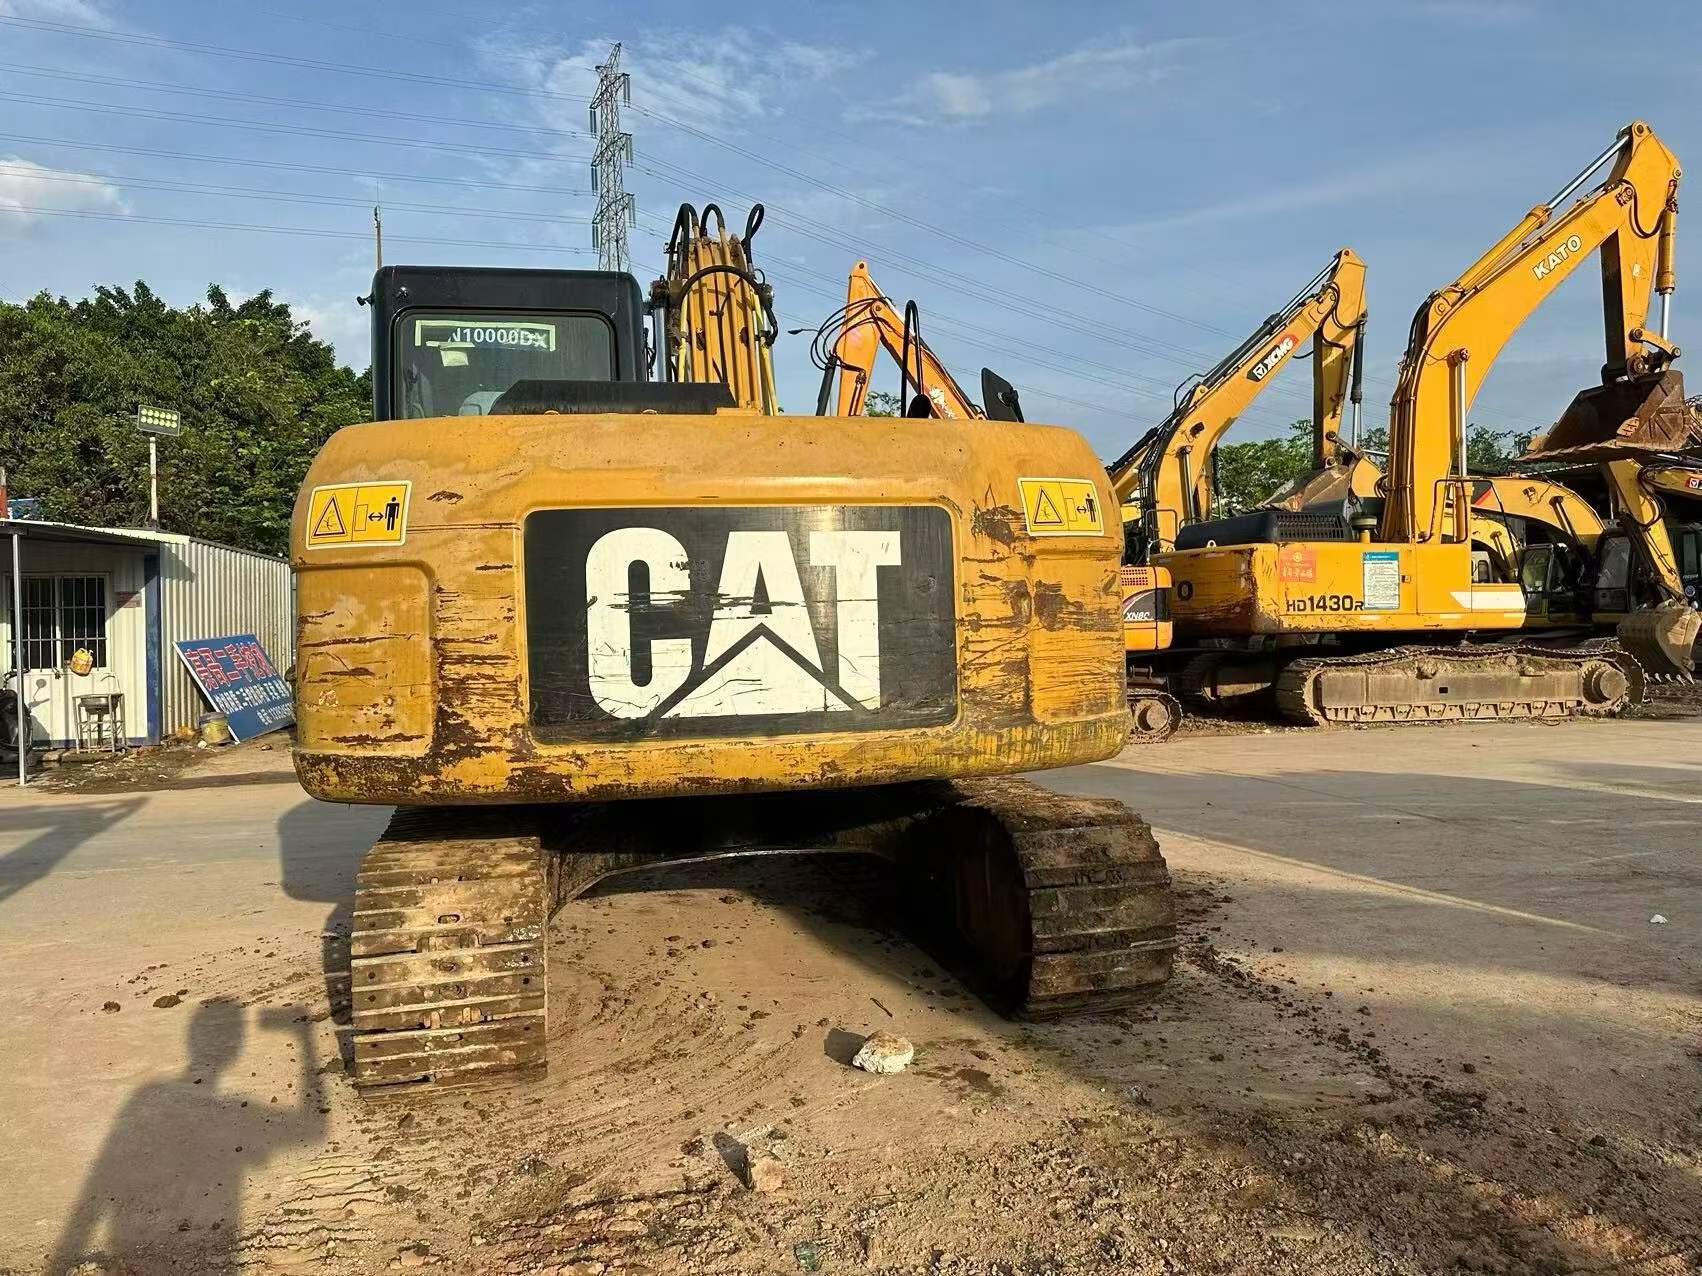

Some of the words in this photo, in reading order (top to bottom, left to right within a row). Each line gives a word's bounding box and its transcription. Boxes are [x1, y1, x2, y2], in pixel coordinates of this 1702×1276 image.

[1532, 234, 1582, 281] KATO
[585, 527, 902, 720] CAT
[1286, 594, 1364, 612] HD1430R
